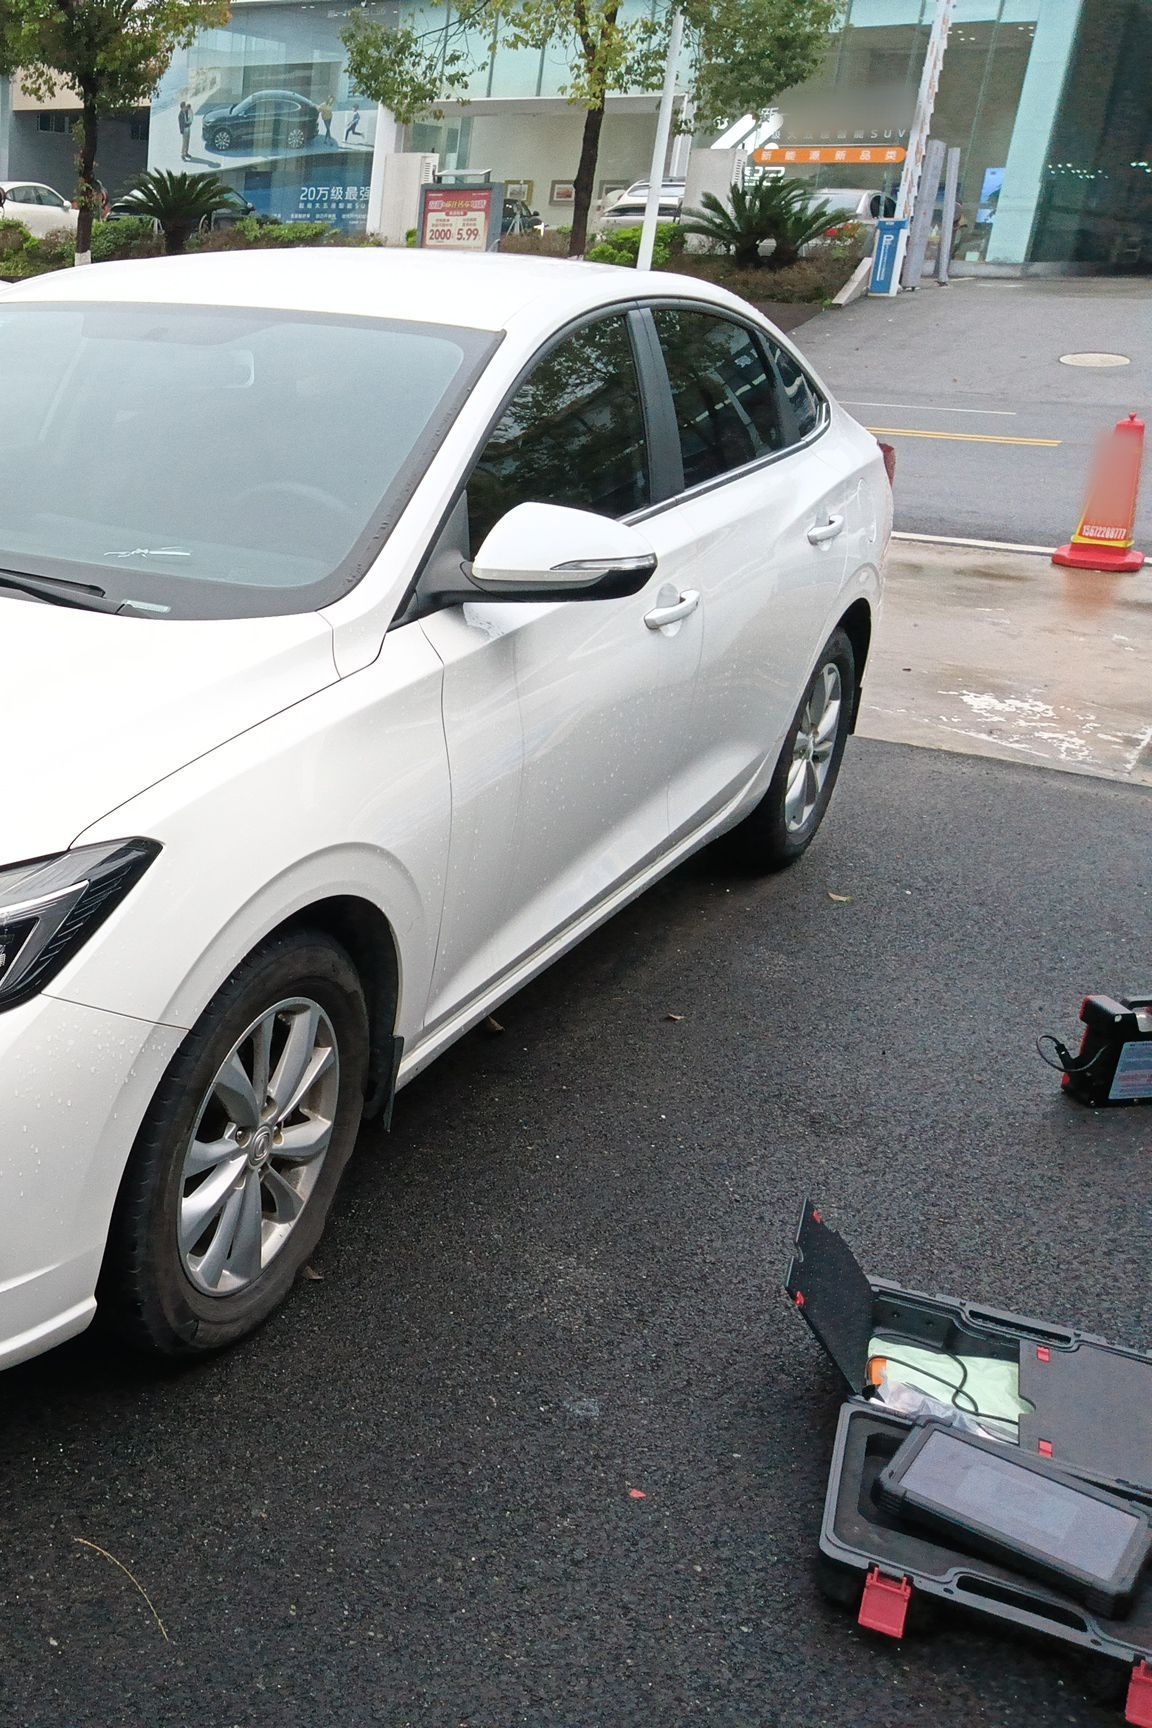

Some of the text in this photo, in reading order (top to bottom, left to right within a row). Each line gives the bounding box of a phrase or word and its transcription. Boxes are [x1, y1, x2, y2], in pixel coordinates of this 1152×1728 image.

[761, 150, 897, 161] 新能源新品类
[429, 228, 479, 241] 2000 5.99
